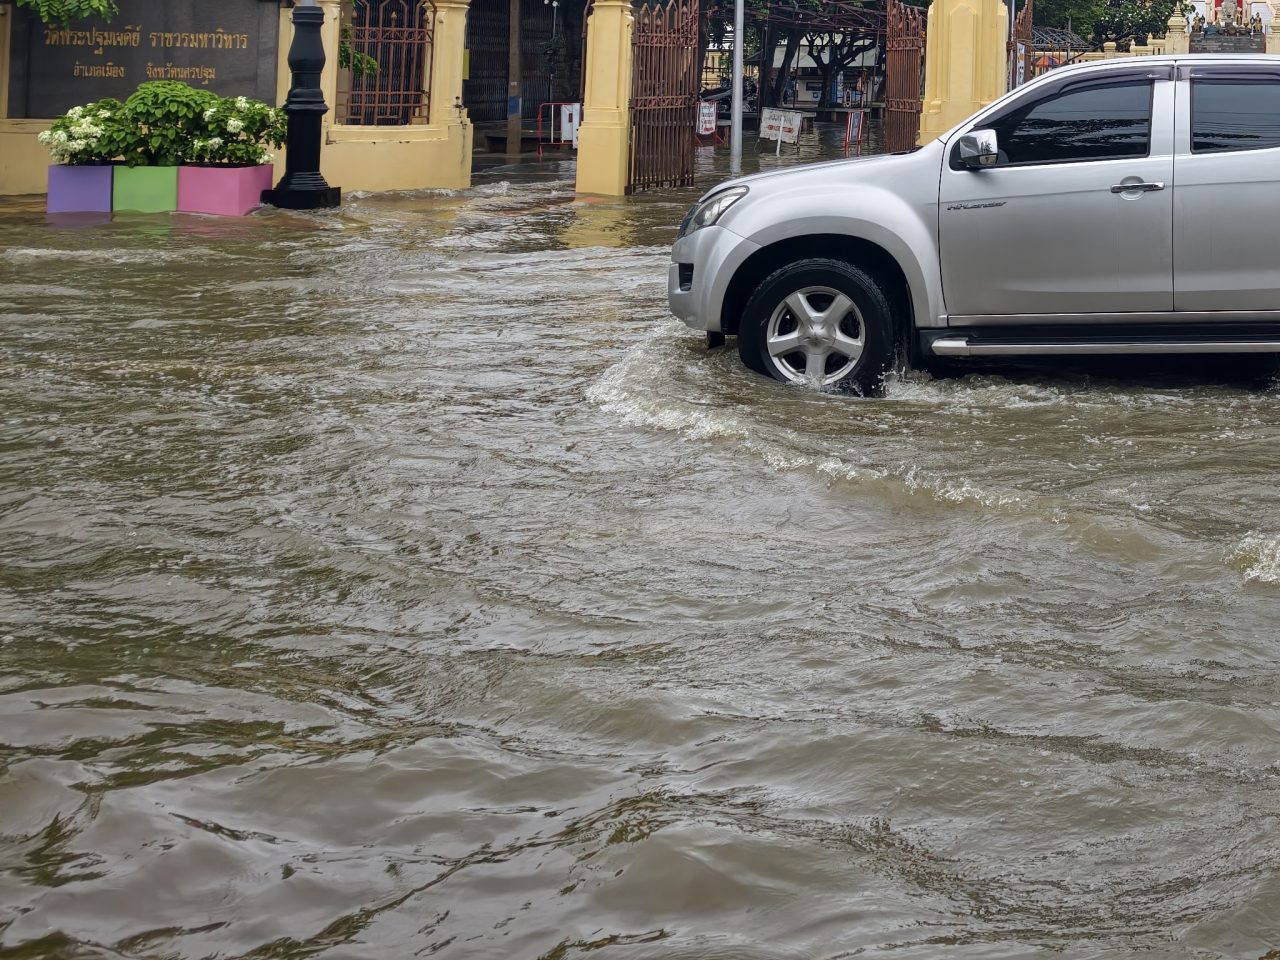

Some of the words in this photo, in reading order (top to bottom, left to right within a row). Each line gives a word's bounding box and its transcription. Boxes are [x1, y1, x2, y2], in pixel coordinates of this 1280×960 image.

[44, 24, 142, 55] วัดพระปฐมเจดีย์
[149, 28, 248, 49] ราชวรมหาวิหาร
[73, 60, 126, 78] อำเภอเมือง
[146, 62, 216, 85] จังหวัดนครปฐม
